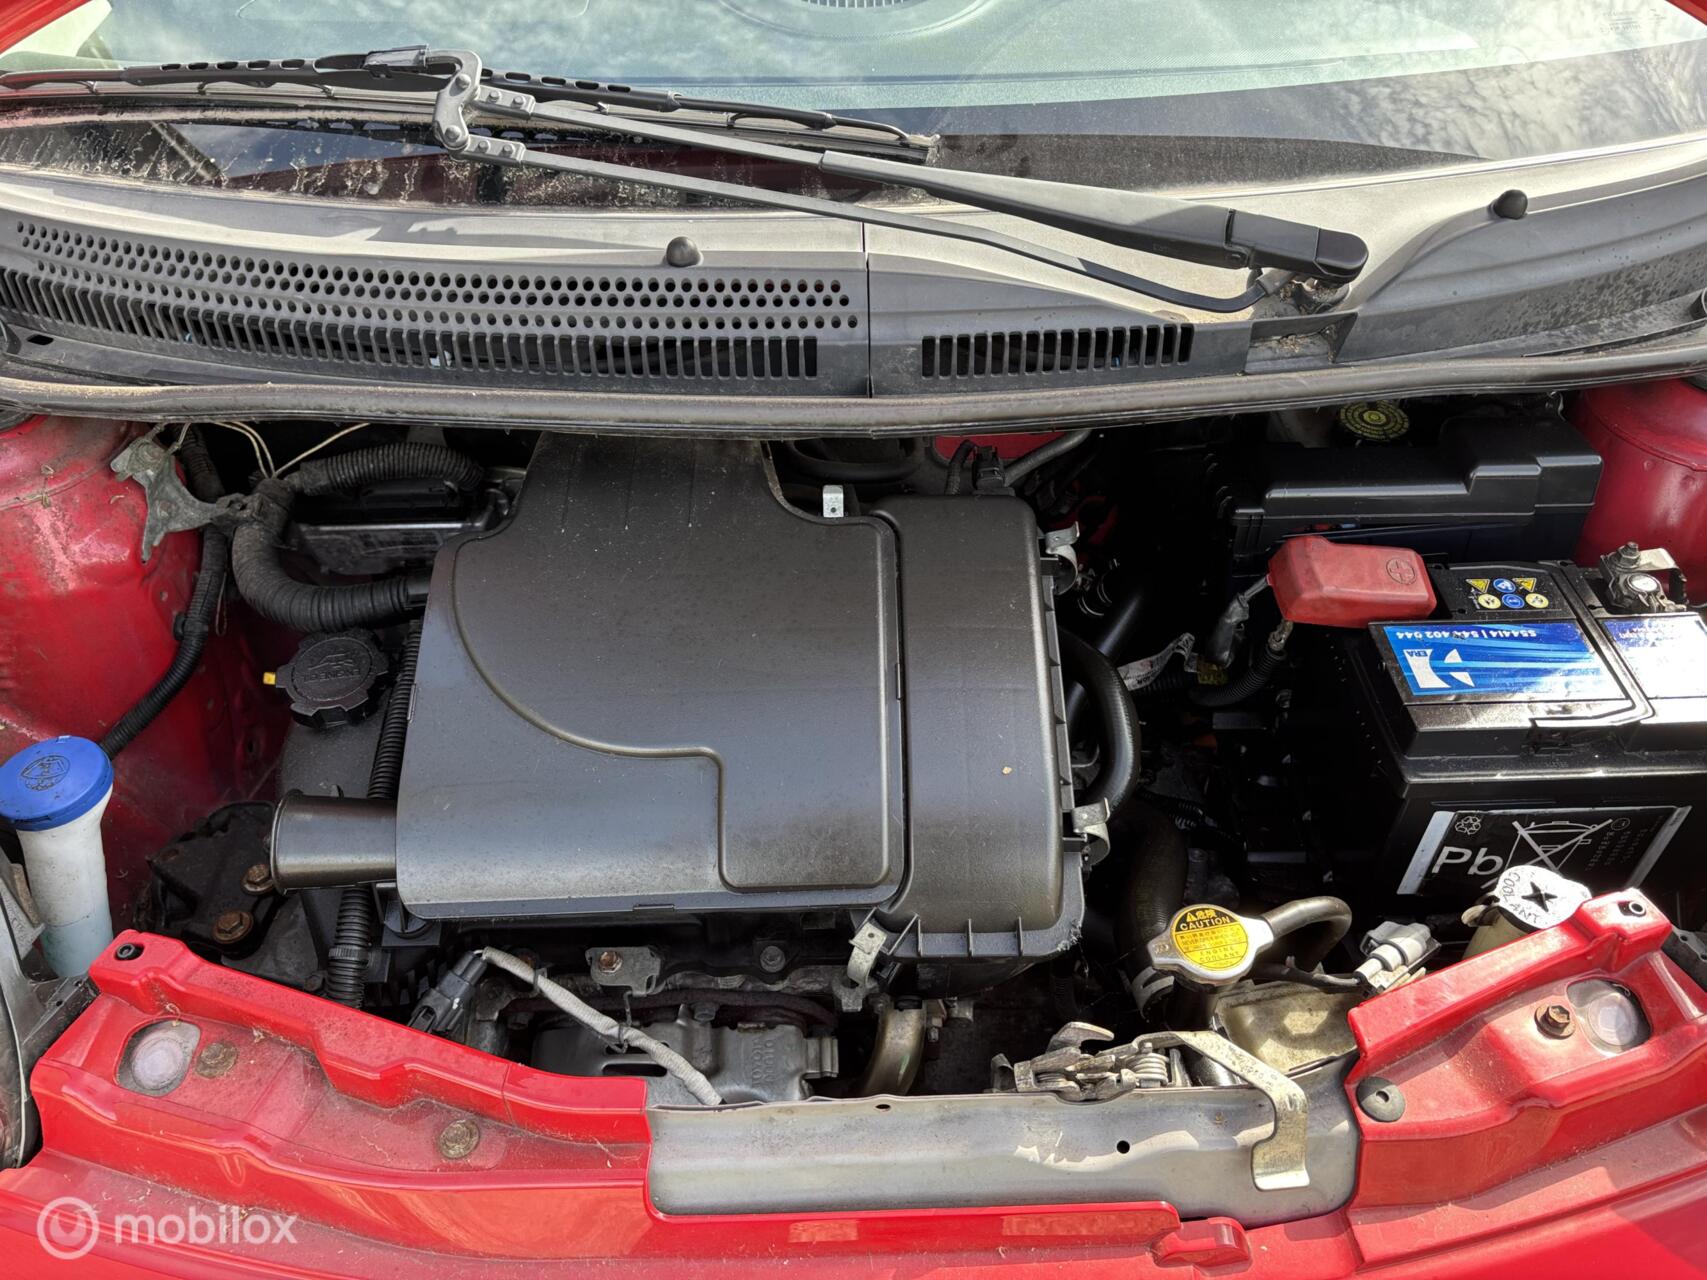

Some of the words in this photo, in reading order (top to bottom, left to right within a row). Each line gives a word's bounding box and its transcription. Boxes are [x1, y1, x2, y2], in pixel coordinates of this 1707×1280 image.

[1425, 630, 1450, 639] 402
[1431, 846, 1504, 876] Pb
[1180, 916, 1231, 931] CAUTION
[1200, 946, 1234, 956] ENGINE
[1199, 952, 1239, 962] COOLANT
